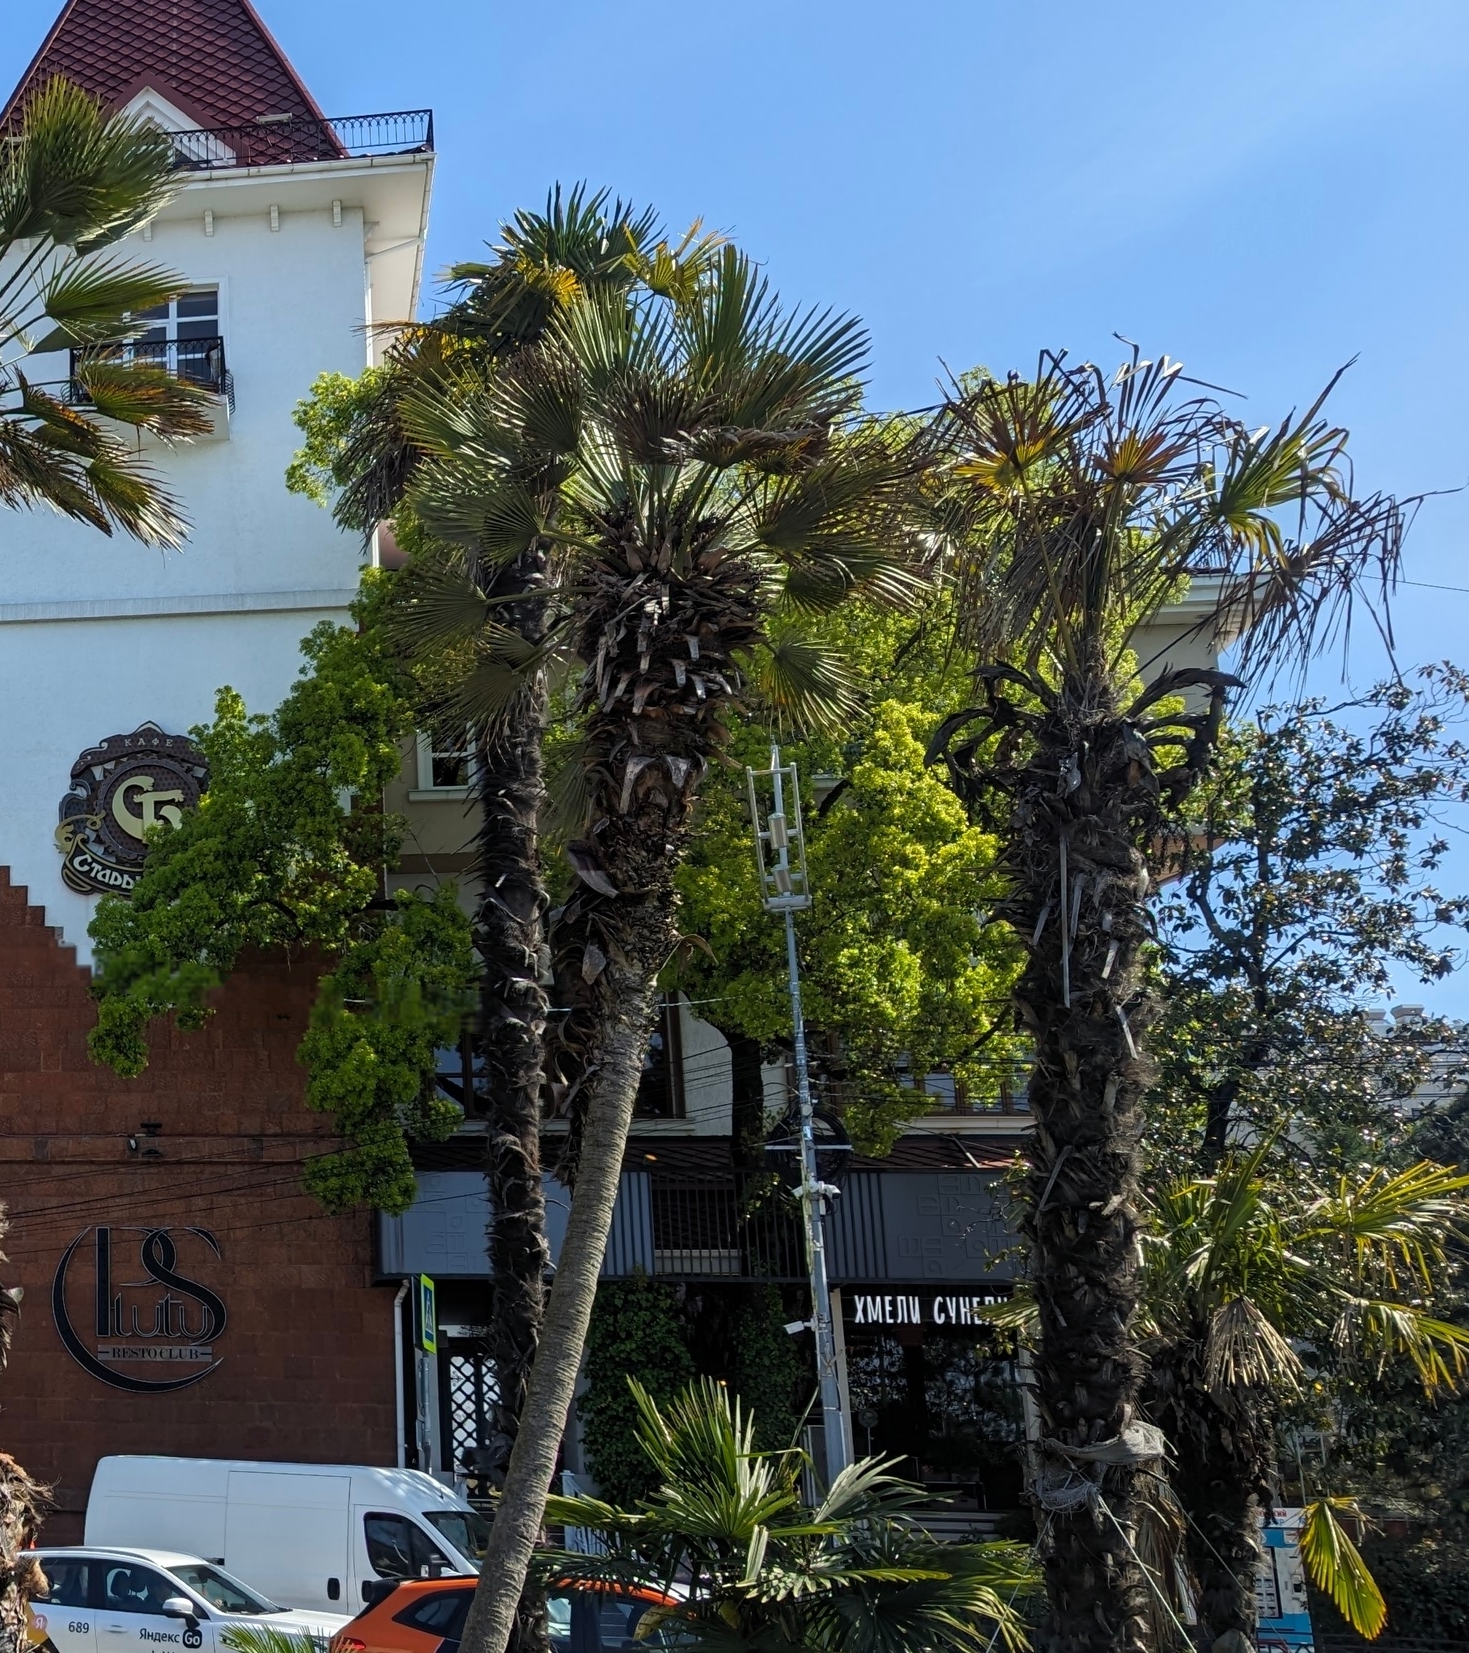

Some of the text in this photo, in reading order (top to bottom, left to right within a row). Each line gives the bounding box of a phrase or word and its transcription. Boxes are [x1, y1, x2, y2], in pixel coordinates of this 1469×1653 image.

[124, 738, 173, 747] КАФЕ
[854, 1295, 921, 1325] ХМЕЛИ
[112, 1347, 199, 1359] RESTO CLUB
[68, 1621, 89, 1633] 689
[139, 1628, 200, 1646] Яндекс Go
